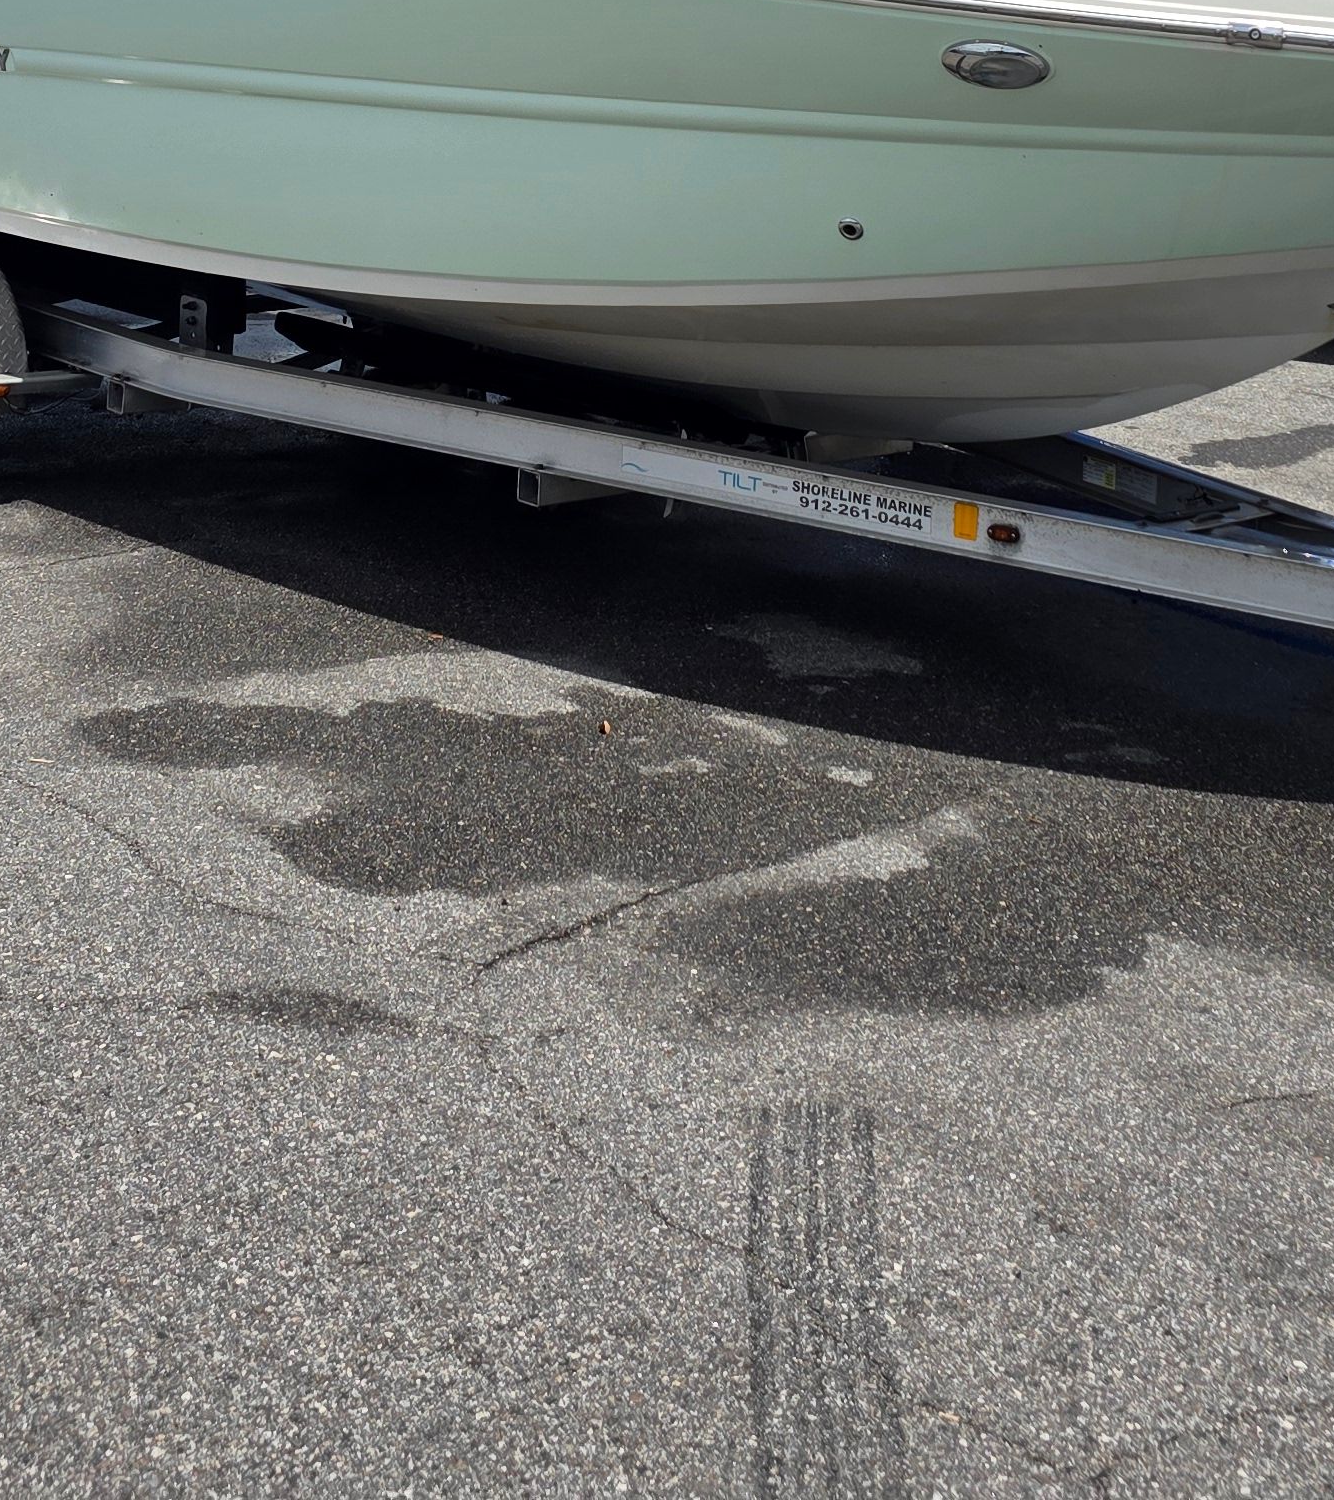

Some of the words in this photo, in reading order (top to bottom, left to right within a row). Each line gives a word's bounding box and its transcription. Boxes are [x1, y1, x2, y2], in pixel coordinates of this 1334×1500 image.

[718, 469, 762, 492] TILT
[792, 480, 872, 507] SHORELINE
[875, 496, 932, 518] MARINE
[799, 496, 923, 531] 912-261-0444
